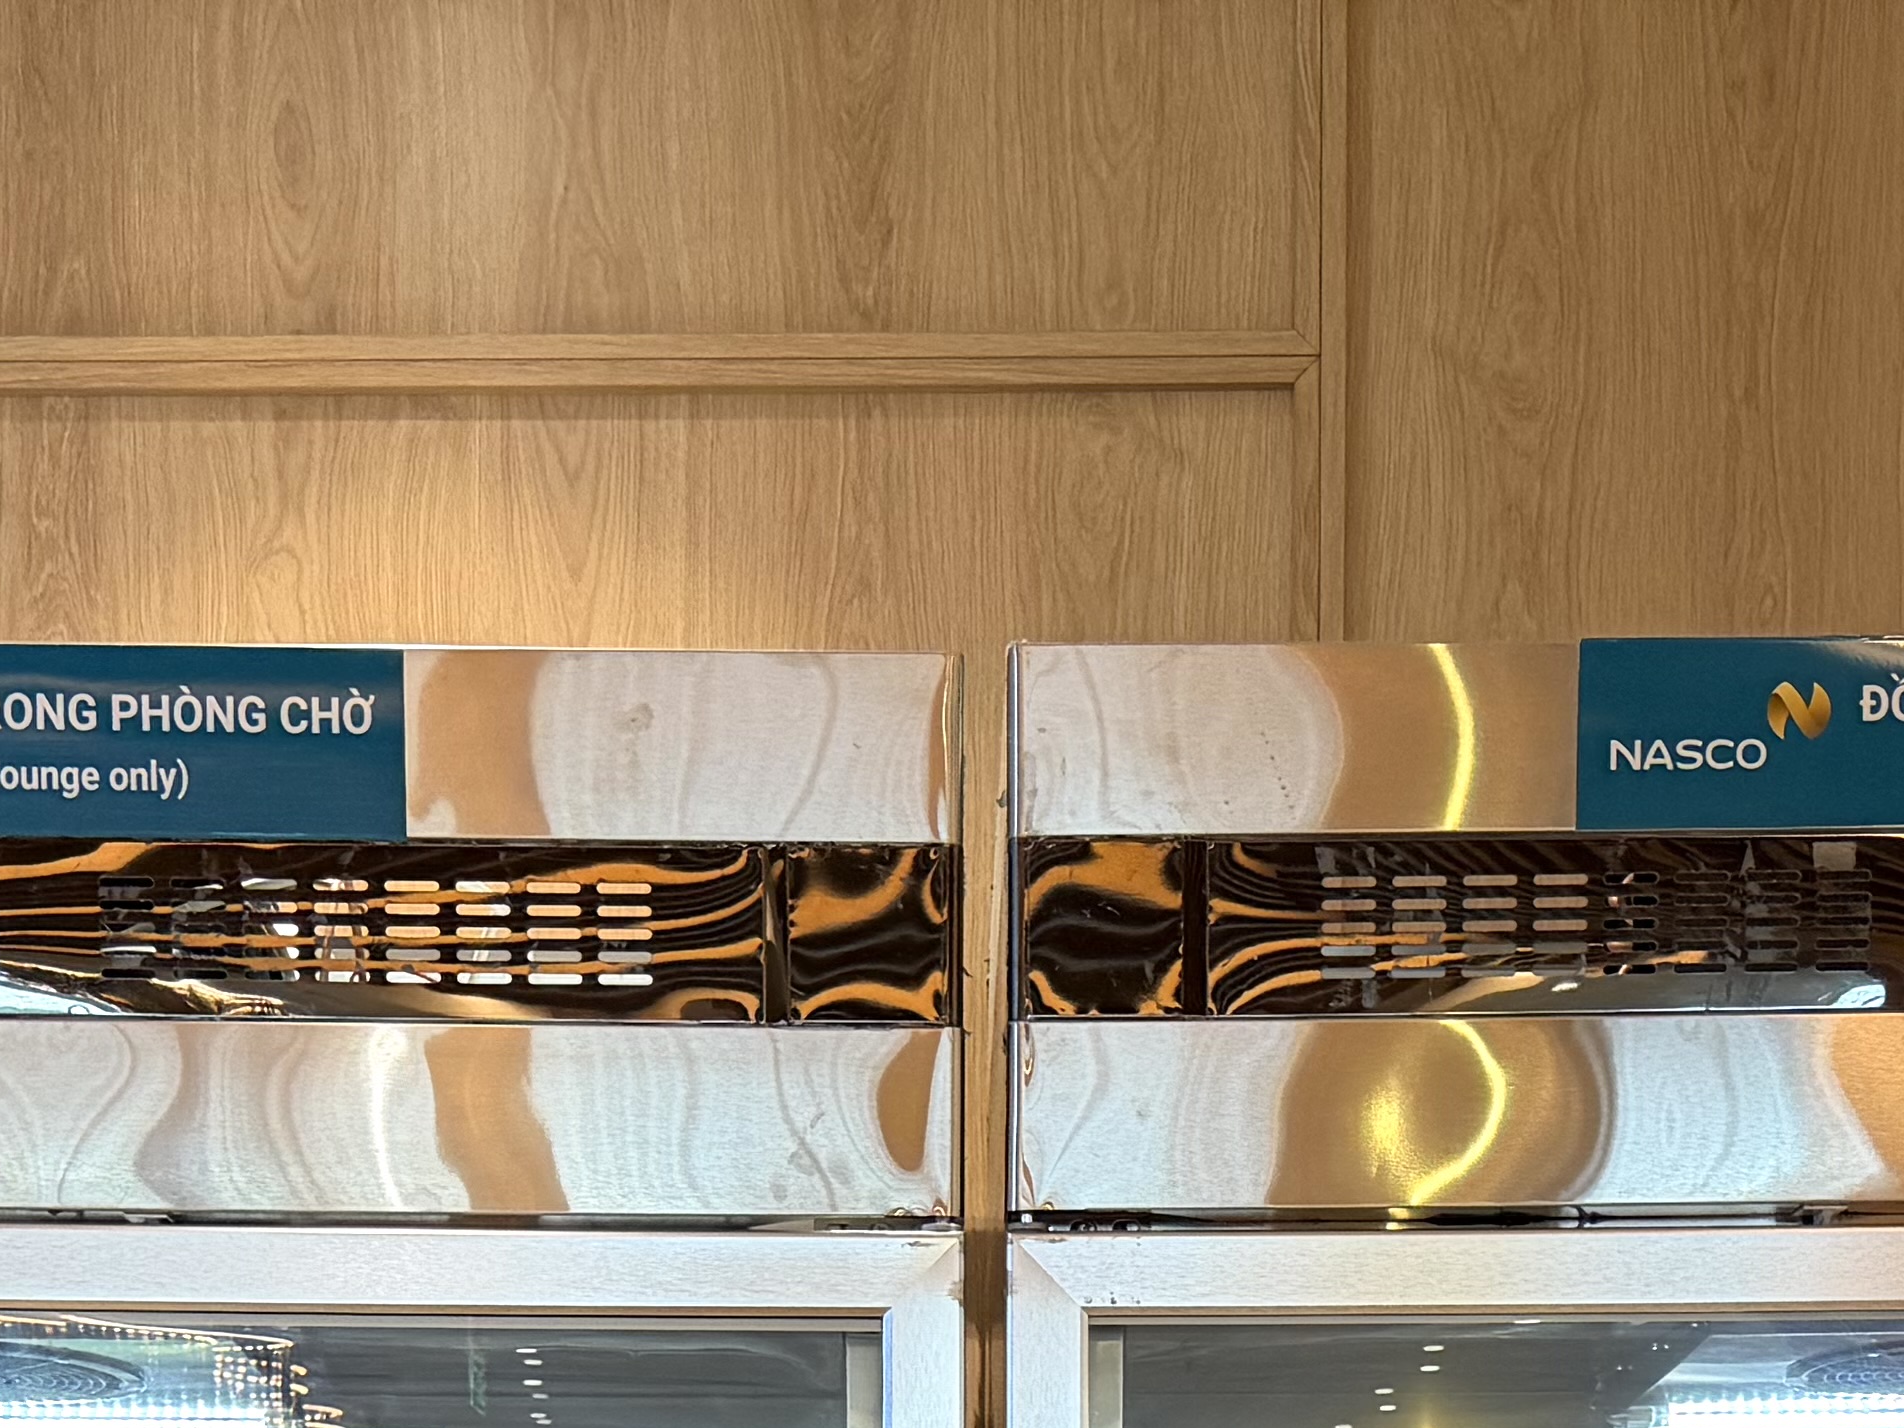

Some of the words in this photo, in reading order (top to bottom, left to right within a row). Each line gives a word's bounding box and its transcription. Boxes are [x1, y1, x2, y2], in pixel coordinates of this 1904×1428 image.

[111, 685, 268, 734] PHÒNG
[280, 687, 376, 735] CHỜ
[1609, 738, 1768, 771] NASCO
[109, 757, 189, 800] only)
